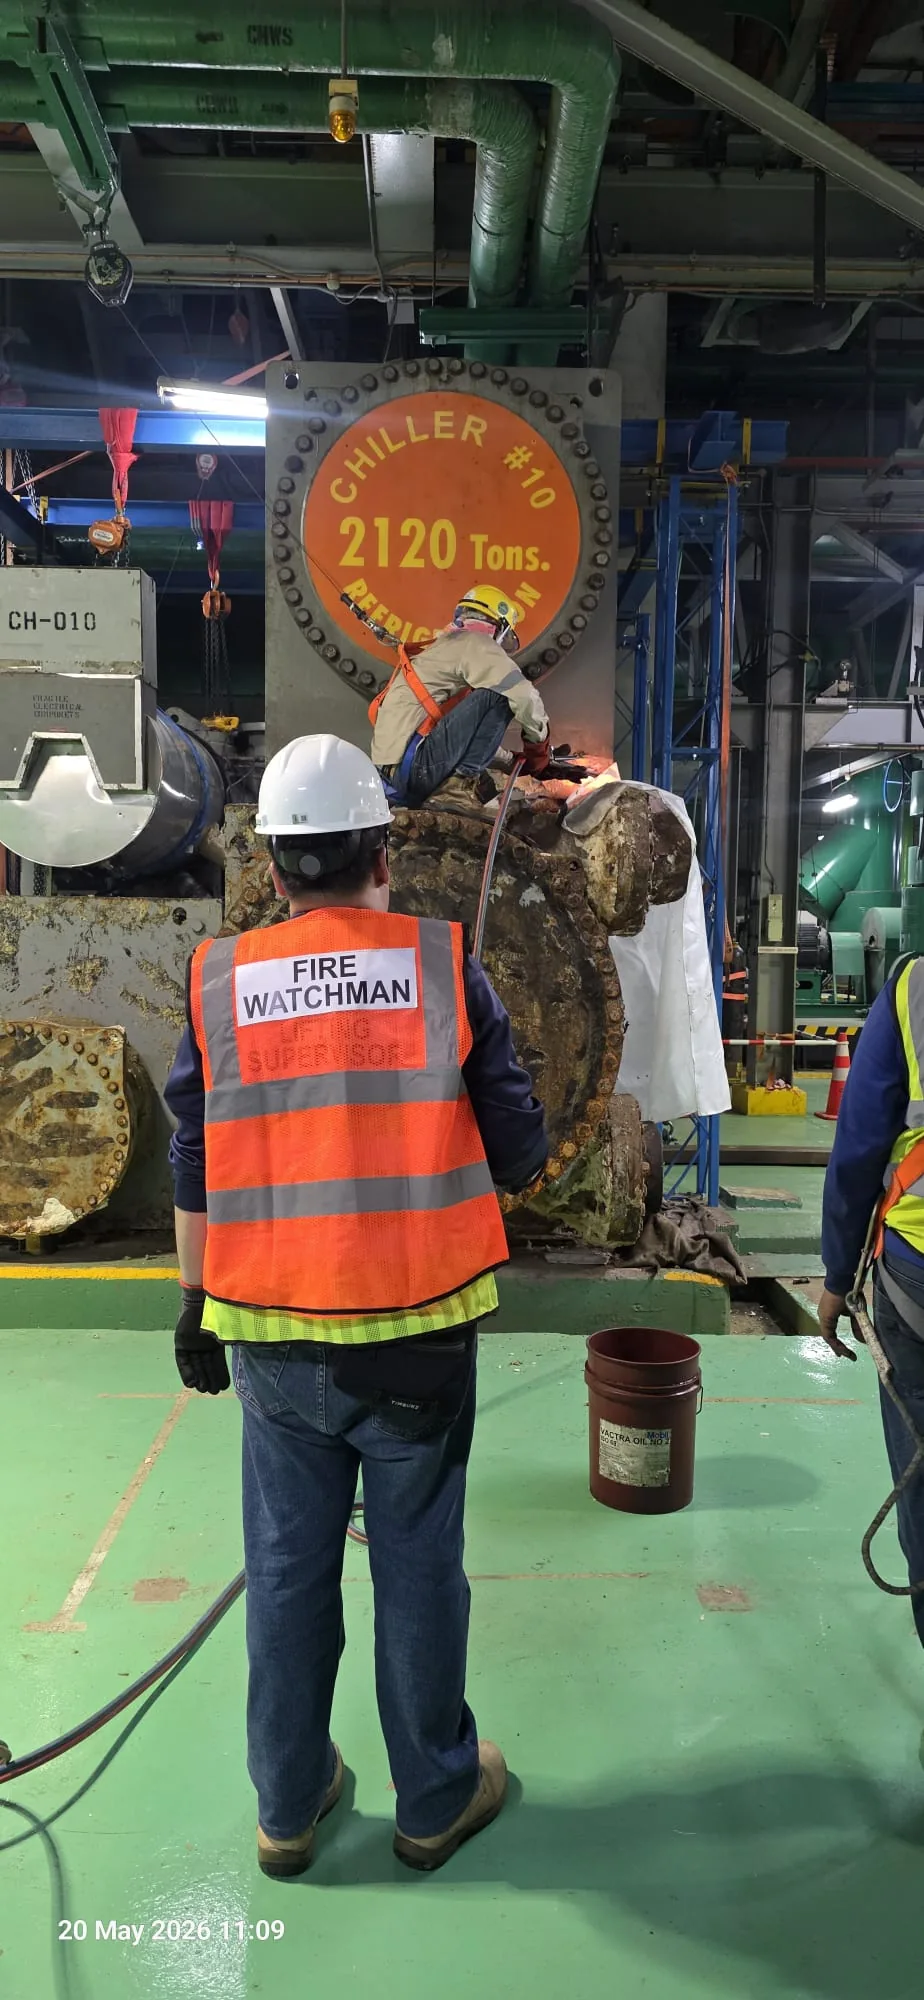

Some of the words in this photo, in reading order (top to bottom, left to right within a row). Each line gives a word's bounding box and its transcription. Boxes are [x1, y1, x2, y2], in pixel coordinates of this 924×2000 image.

[330, 411, 488, 504] CHILLER
[503, 445, 556, 509] #10
[339, 516, 457, 570] 2120
[470, 534, 550, 571] Tons.
[8, 611, 96, 631] CH-010
[293, 955, 357, 983] FIRE
[243, 979, 411, 1019] WATCHMAN
[248, 1043, 404, 1073] SUPERVISOR
[600, 1426, 631, 1443] VACTRA
[633, 1437, 648, 1446] OIL
[647, 1431, 669, 1439] Mobil
